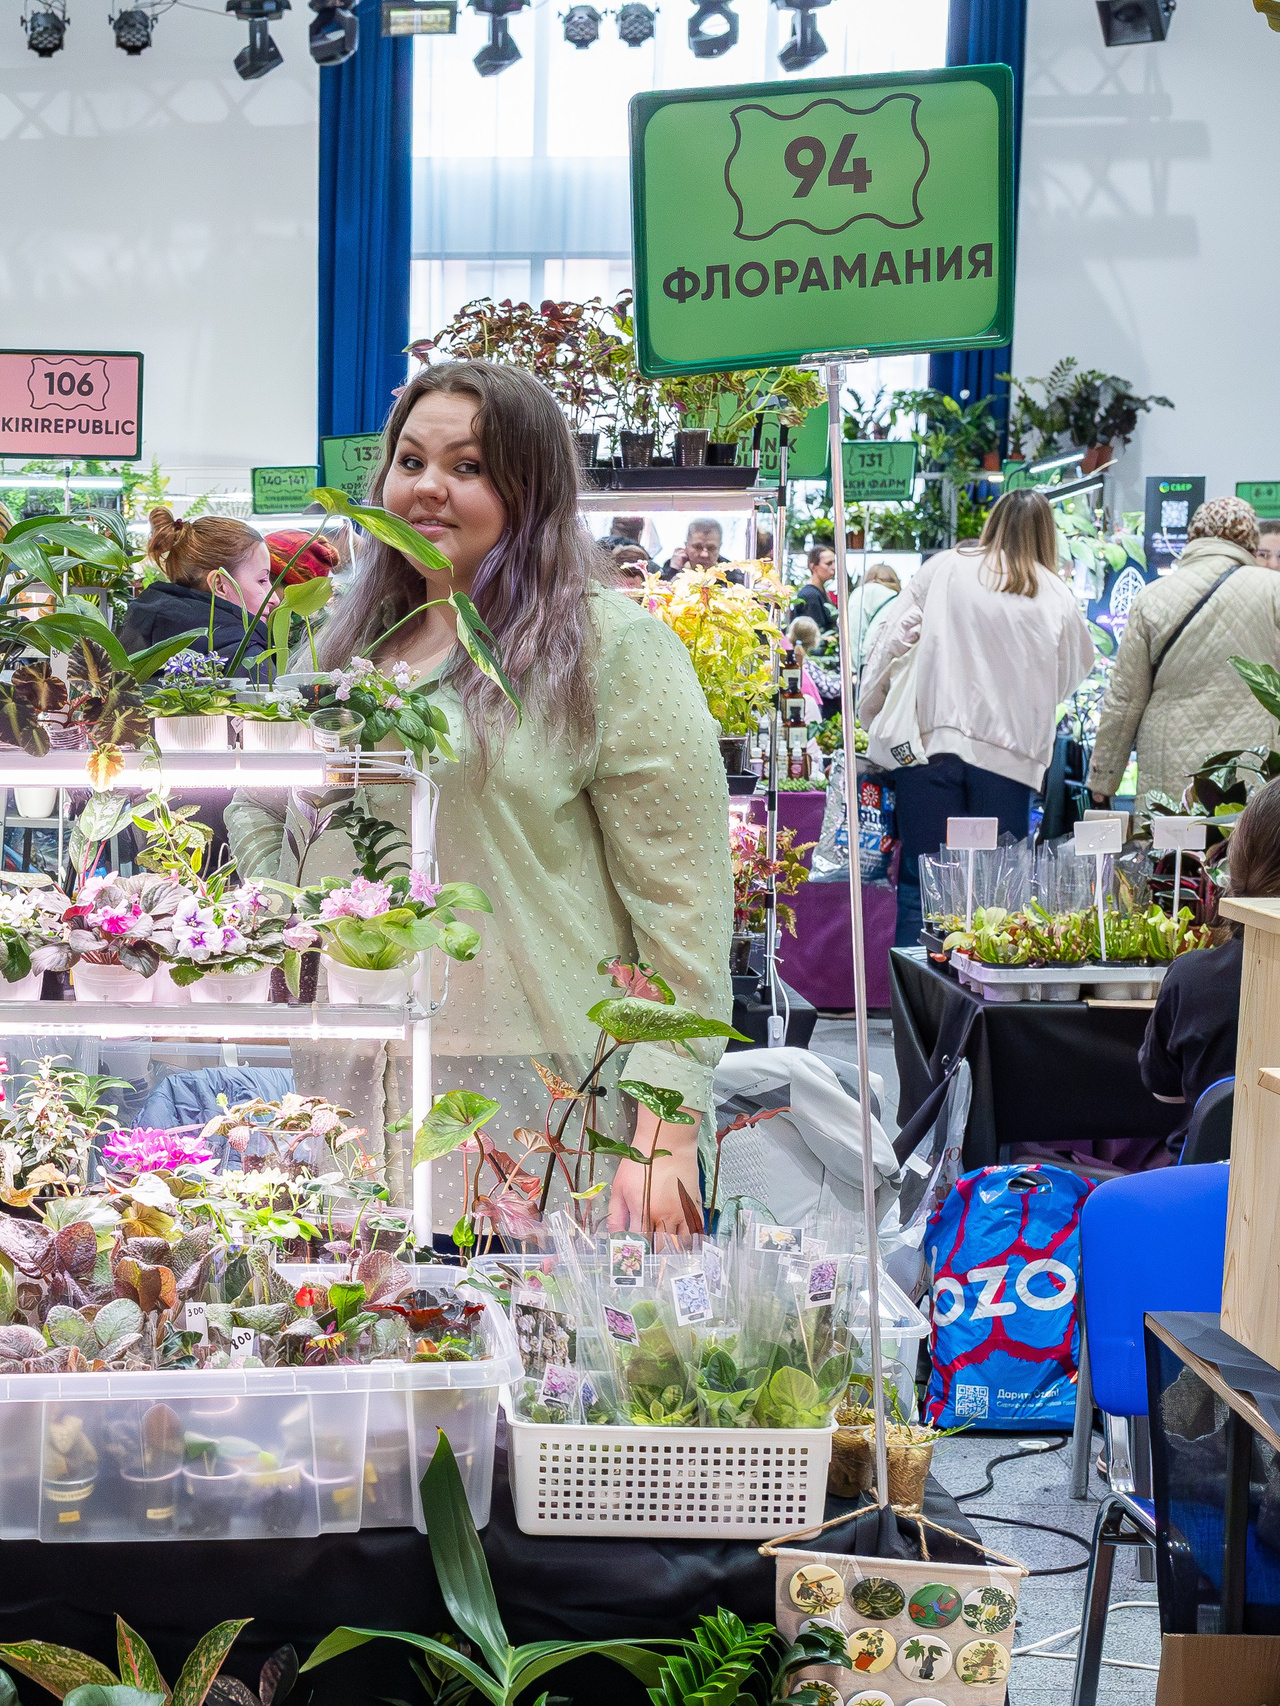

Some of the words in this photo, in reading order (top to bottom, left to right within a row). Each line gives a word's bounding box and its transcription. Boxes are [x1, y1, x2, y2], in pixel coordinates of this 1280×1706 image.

[784, 133, 872, 198] 94
[662, 242, 995, 304] ФЛОРАМАНИЯ
[43, 371, 95, 397] 106
[1, 417, 135, 436] KIRIREPUBLIC
[858, 453, 883, 468] 131
[188, 1306, 204, 1317] 300
[232, 1332, 252, 1350] 800
